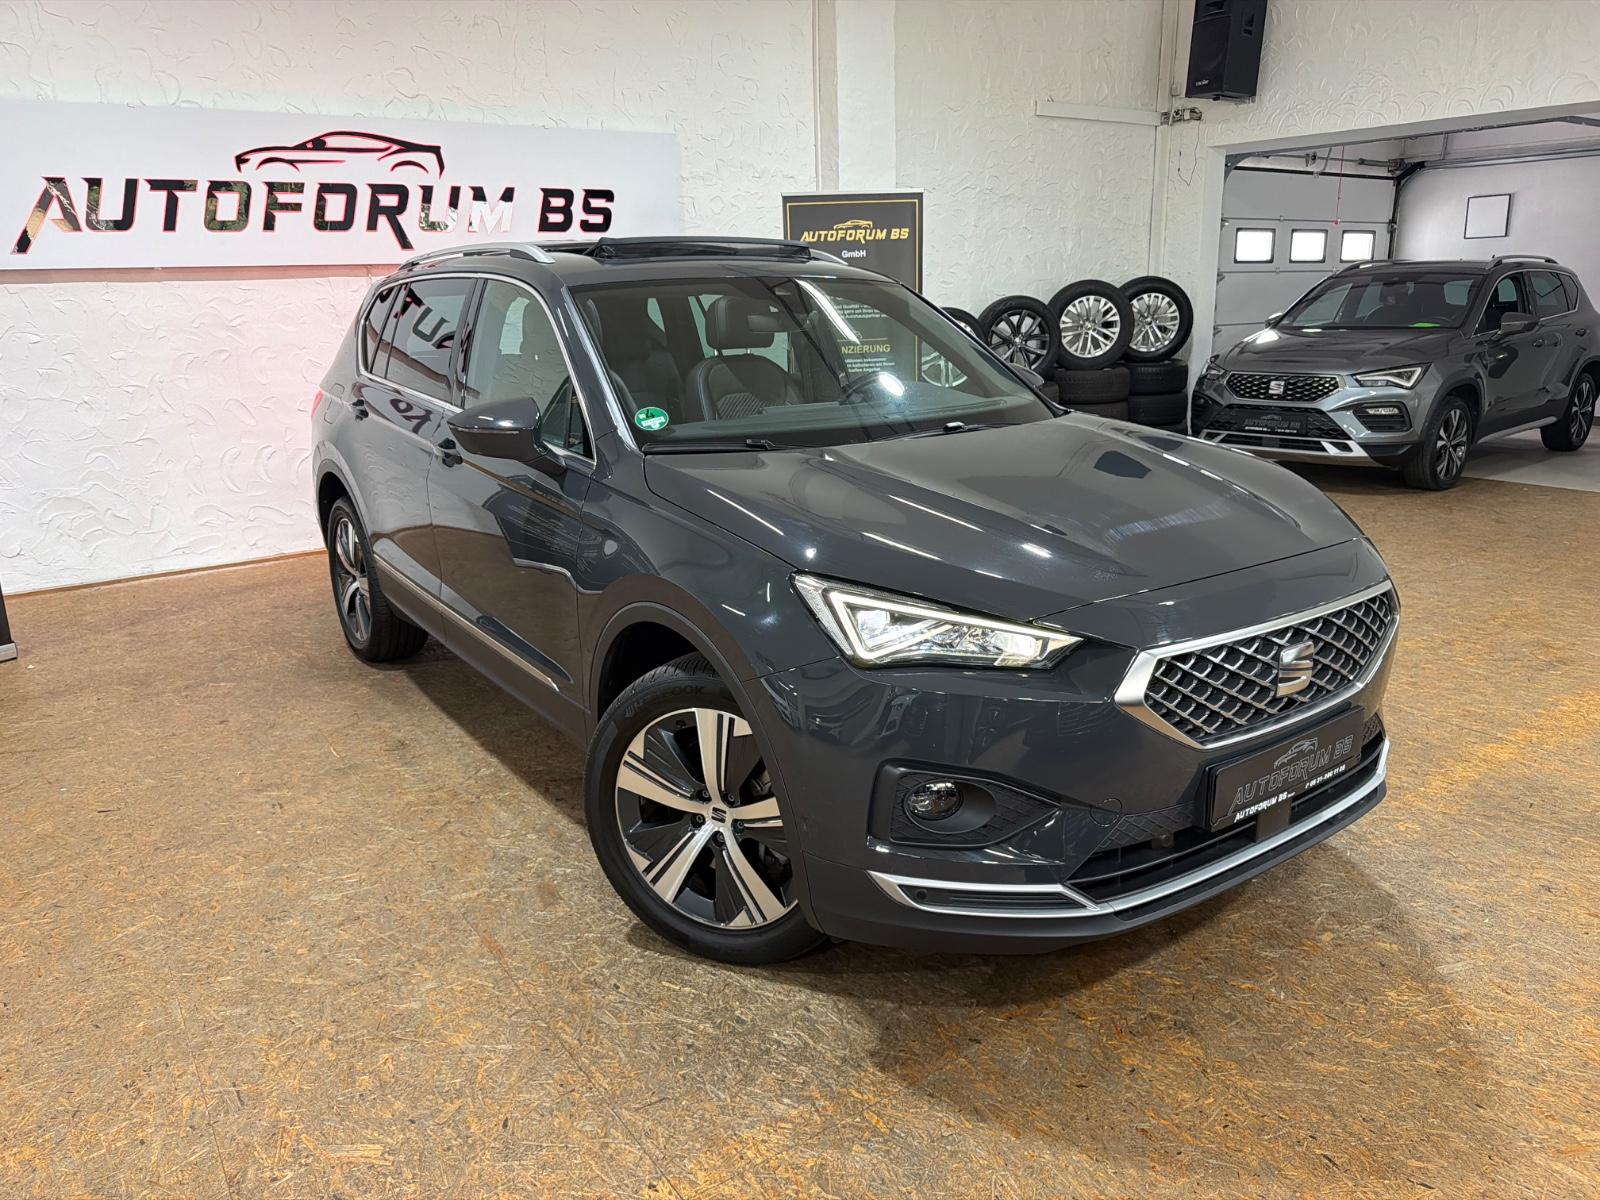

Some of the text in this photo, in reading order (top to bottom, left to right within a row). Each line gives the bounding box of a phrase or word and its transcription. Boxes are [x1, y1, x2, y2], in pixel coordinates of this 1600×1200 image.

[11, 176, 614, 254] AUTOFORUM BS
[800, 228, 909, 244] AUTOFORUM BS
[841, 250, 867, 258] GmbH
[1228, 734, 1354, 815] AUTOFORUM BS
[1234, 794, 1278, 823] AUTOFORUM
